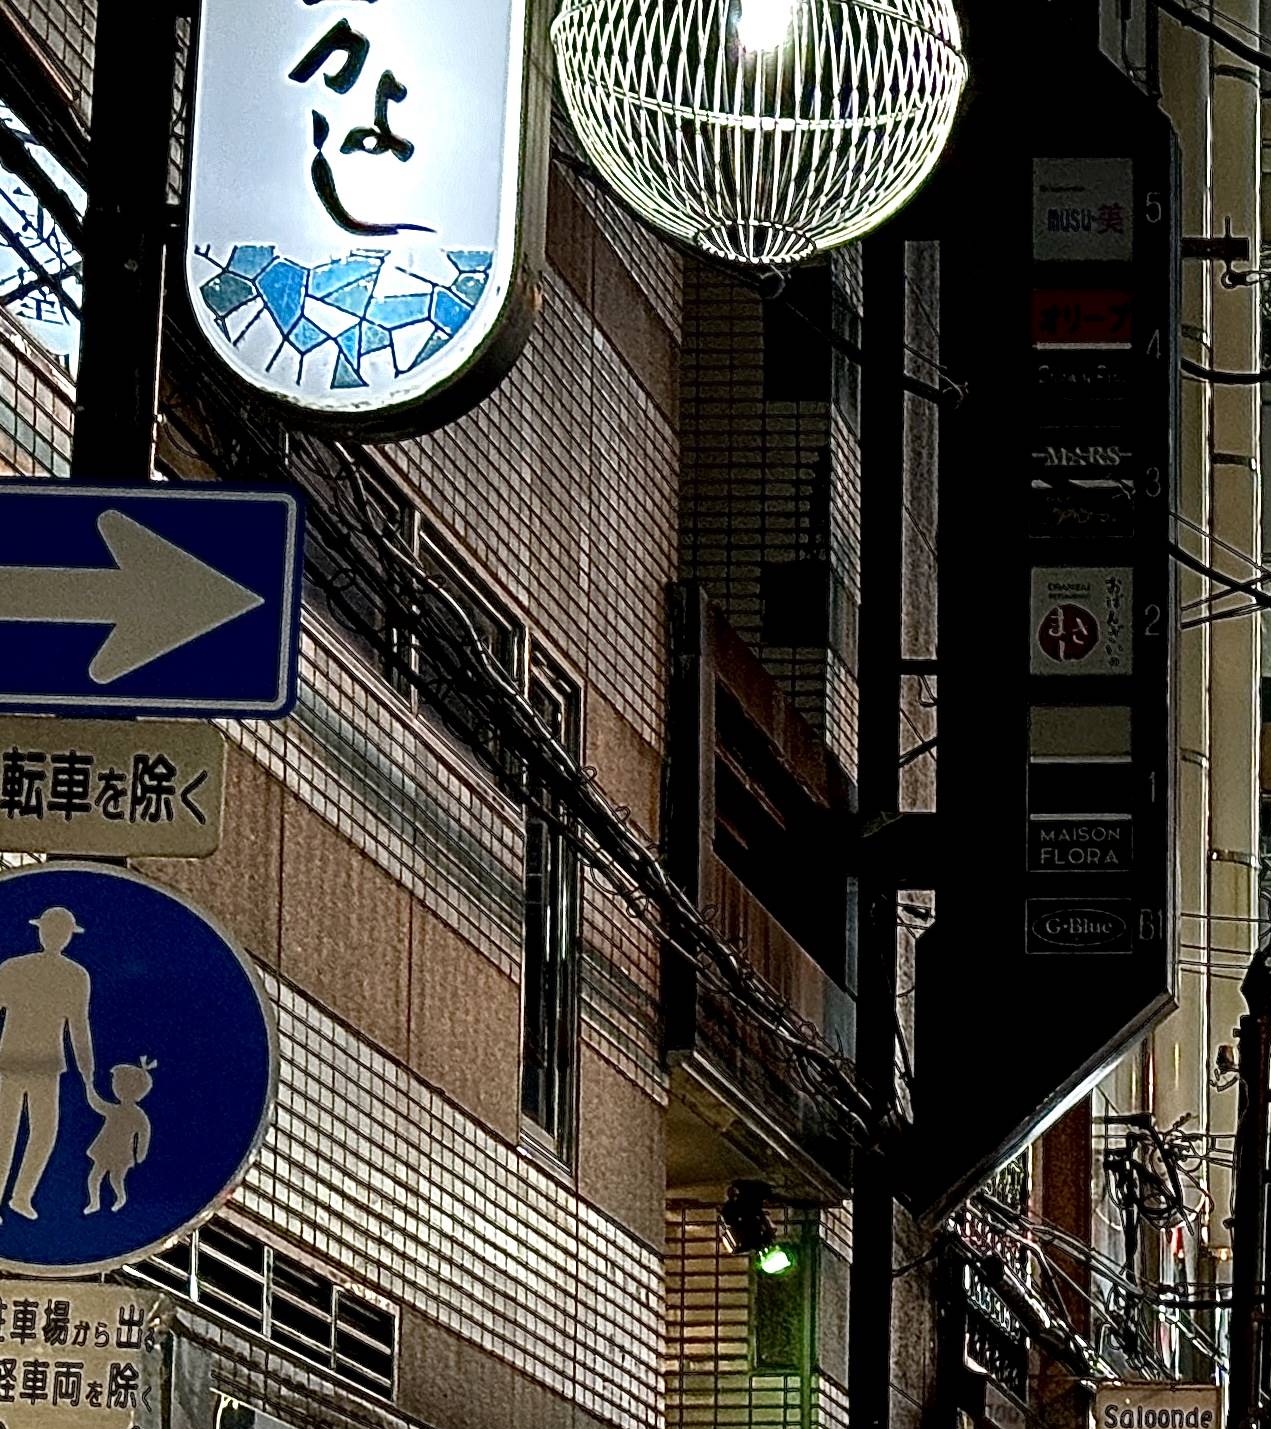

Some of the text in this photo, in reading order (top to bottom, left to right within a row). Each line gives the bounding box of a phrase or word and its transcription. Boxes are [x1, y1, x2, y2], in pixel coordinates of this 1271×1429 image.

[1145, 192, 1162, 223] 5
[1145, 466, 1161, 497] 3
[1144, 604, 1161, 636] 2
[1040, 827, 1121, 842] MAISON
[1040, 848, 1119, 865] FLORA
[0, 1298, 156, 1352] 車場から出
[1104, 1404, 1213, 1429] Saloonde
